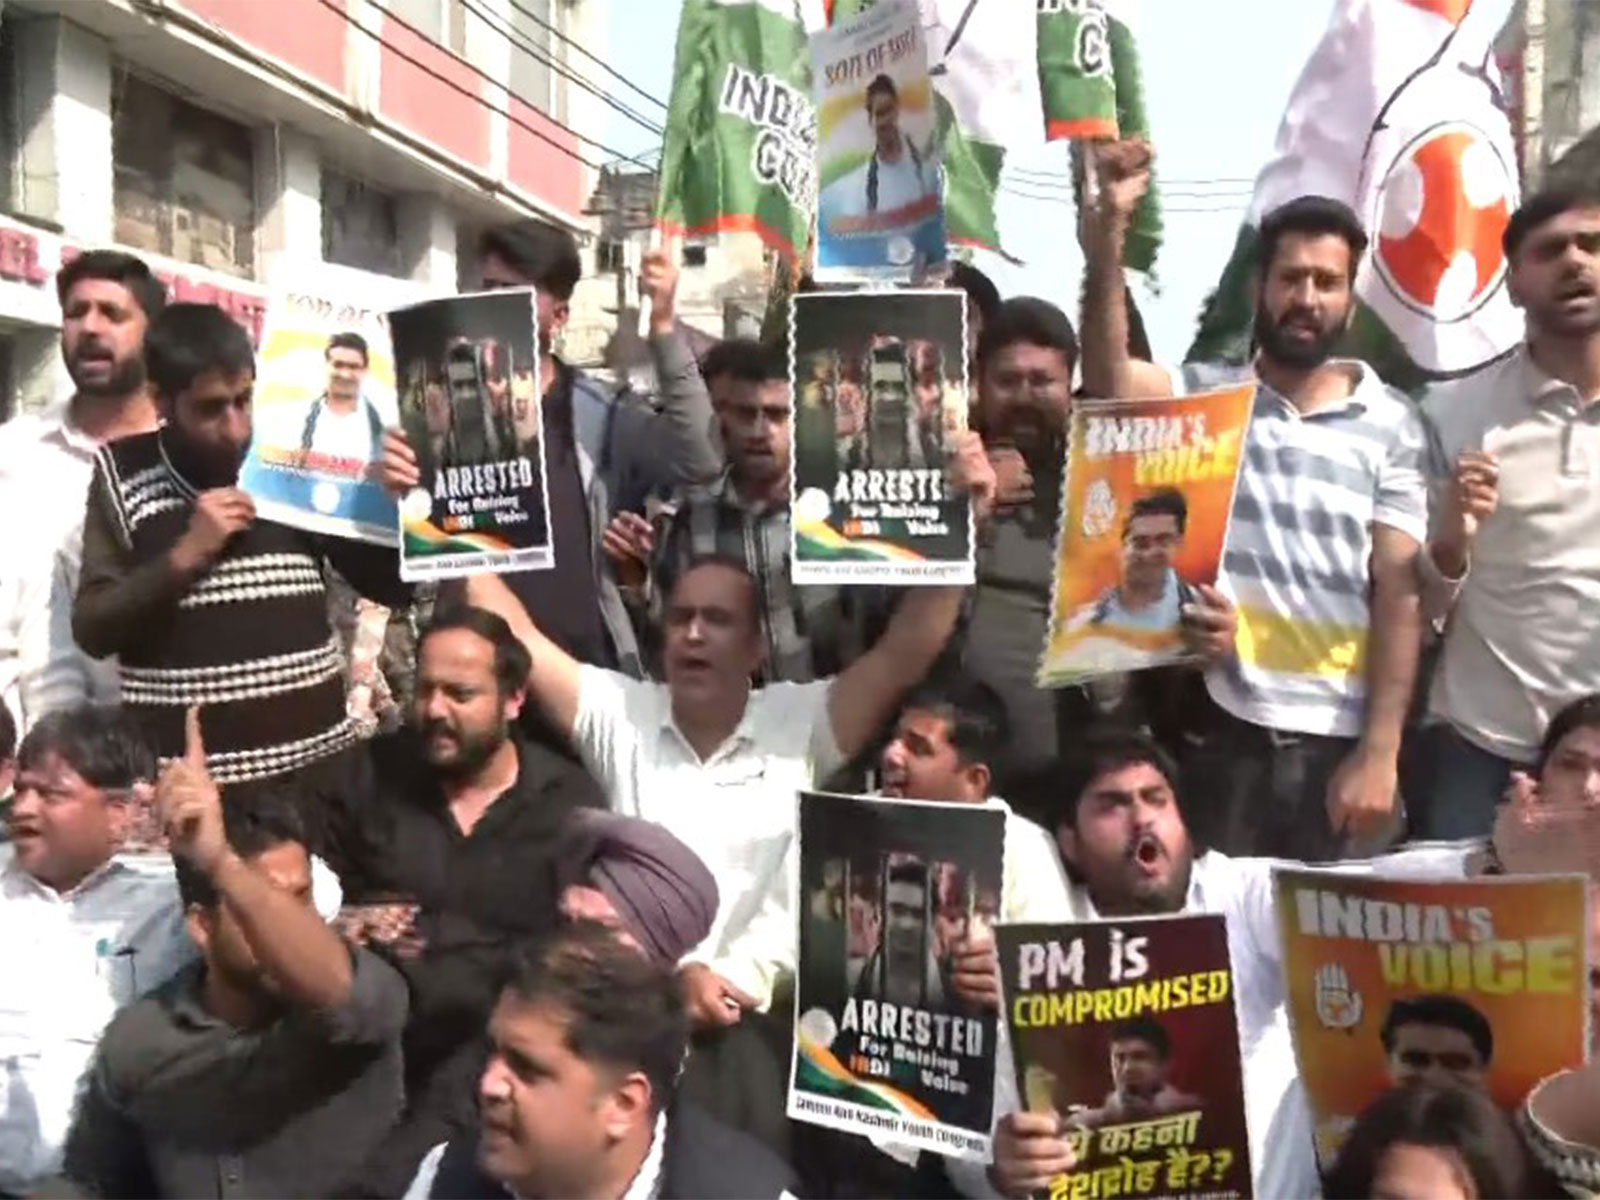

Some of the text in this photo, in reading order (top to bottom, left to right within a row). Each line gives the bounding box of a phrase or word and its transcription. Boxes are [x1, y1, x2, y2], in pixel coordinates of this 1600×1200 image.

[1085, 412, 1217, 461] INDIA'S
[1132, 427, 1242, 485] VOICE
[434, 456, 533, 500] ARRESTED
[833, 468, 948, 503] ARRESTE
[1296, 887, 1494, 945] INDIA'S
[1018, 937, 1086, 991] PM
[1377, 931, 1579, 995] VOICE
[1012, 969, 1230, 1027] COMPROMISED
[841, 997, 983, 1057] ARRESTED
[859, 1035, 888, 1056] For
[1098, 1111, 1202, 1156] कहना
